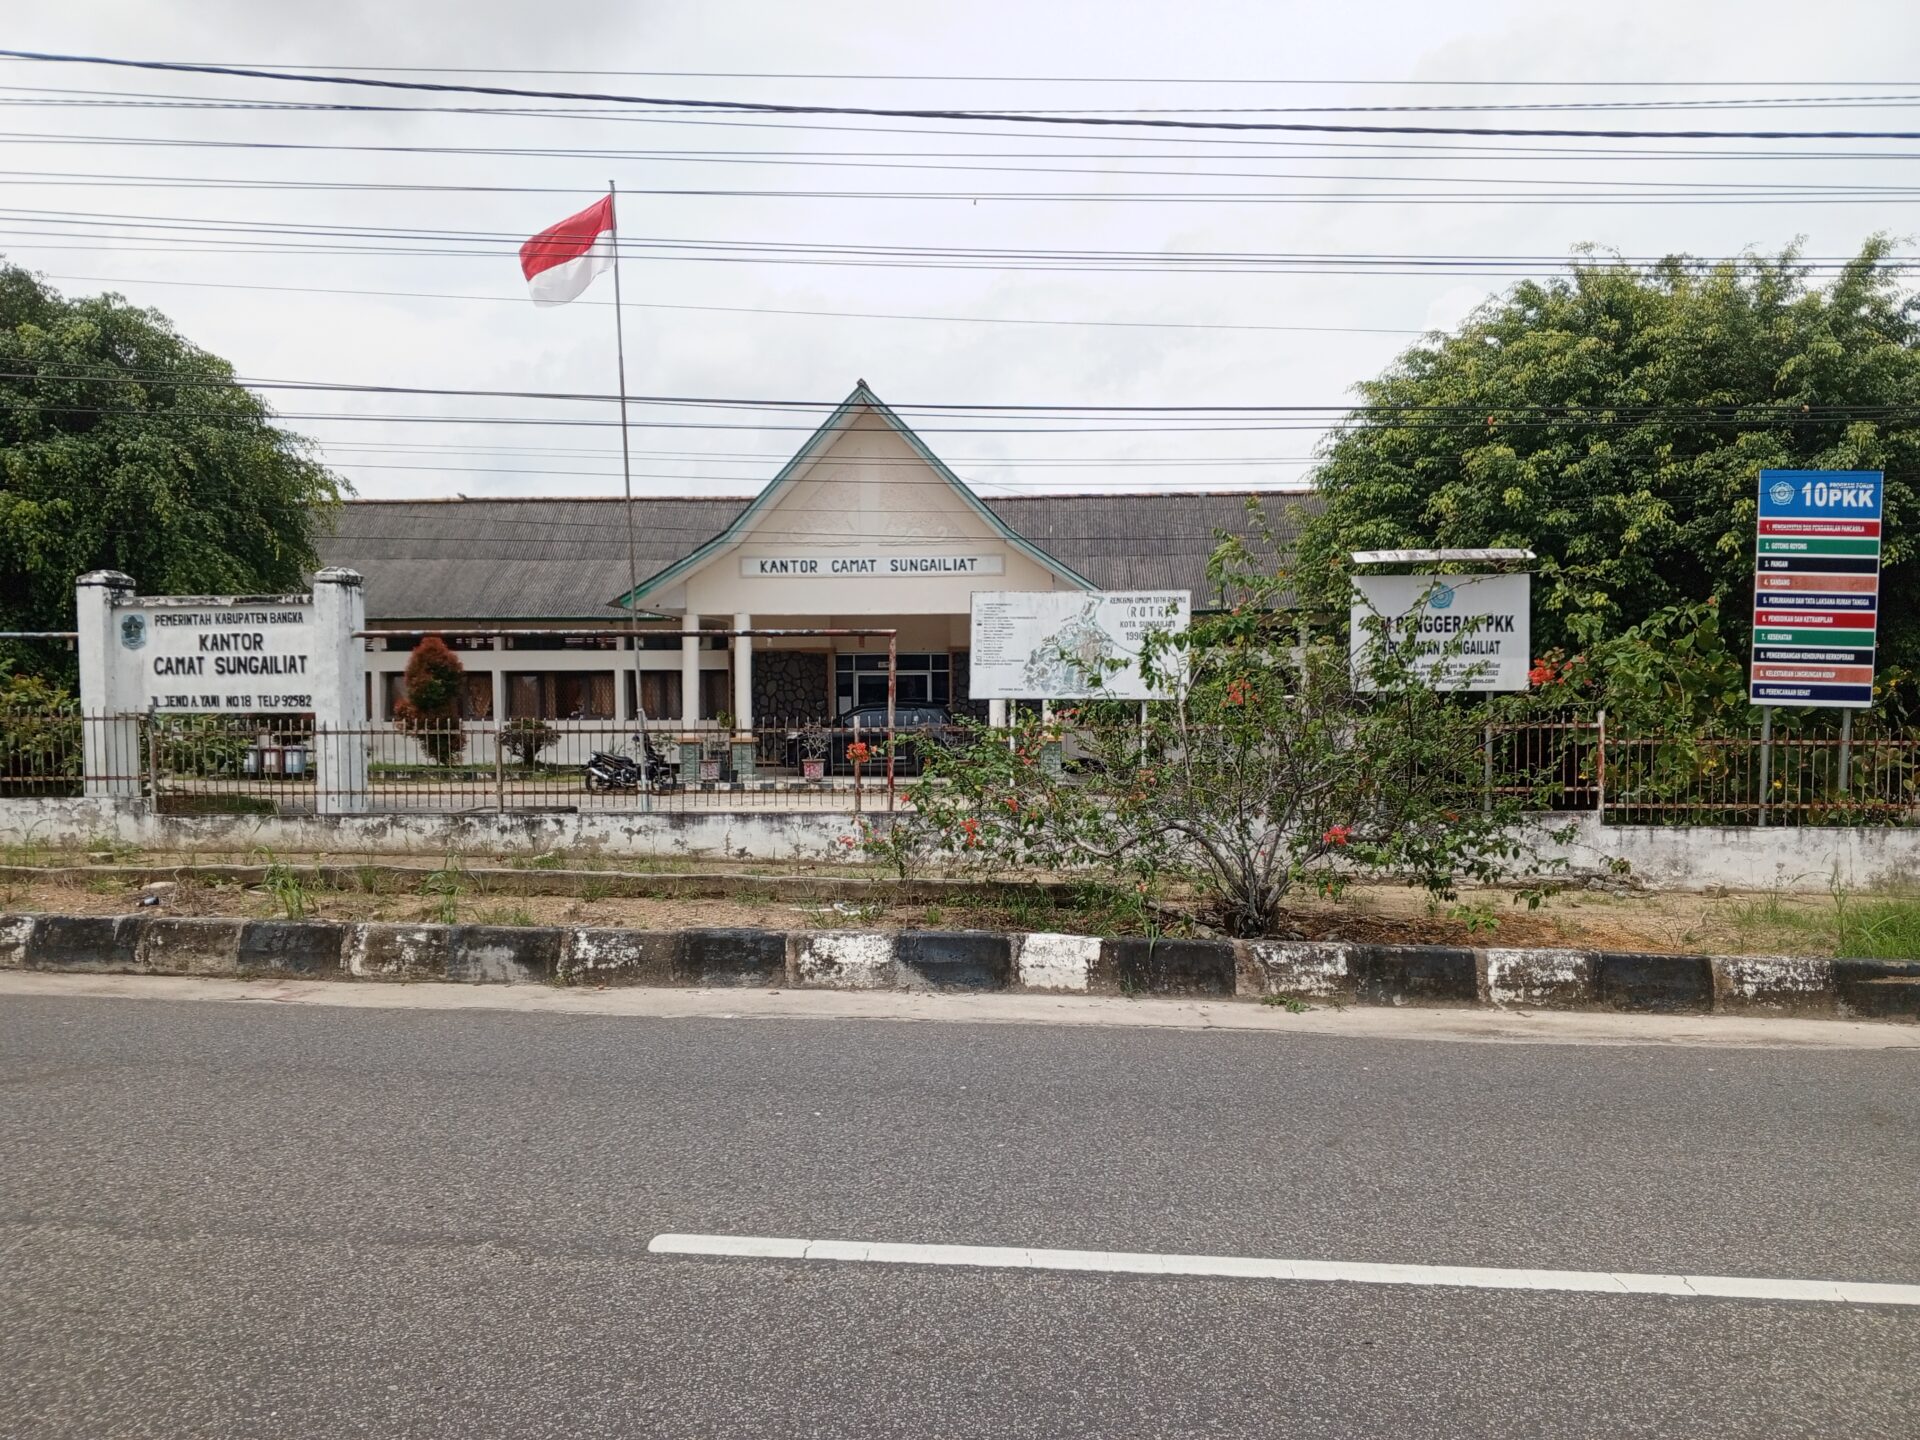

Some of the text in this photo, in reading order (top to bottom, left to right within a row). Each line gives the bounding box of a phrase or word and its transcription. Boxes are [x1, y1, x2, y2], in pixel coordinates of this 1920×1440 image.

[1801, 481, 1874, 508] 10 PKK
[759, 558, 978, 574] KANTOR CAMAT SUNGAILIAT
[154, 611, 304, 627] PEMERINTAH KABUPATEN BANGKA
[1120, 620, 1136, 628] KOTA
[1486, 615, 1515, 632] PKK
[198, 632, 264, 652] KANTOR
[153, 654, 308, 675] CAMAT SUNGAILIAT
[200, 695, 220, 707] YANI
[257, 695, 280, 707] TELP
[281, 694, 312, 707] 92582
